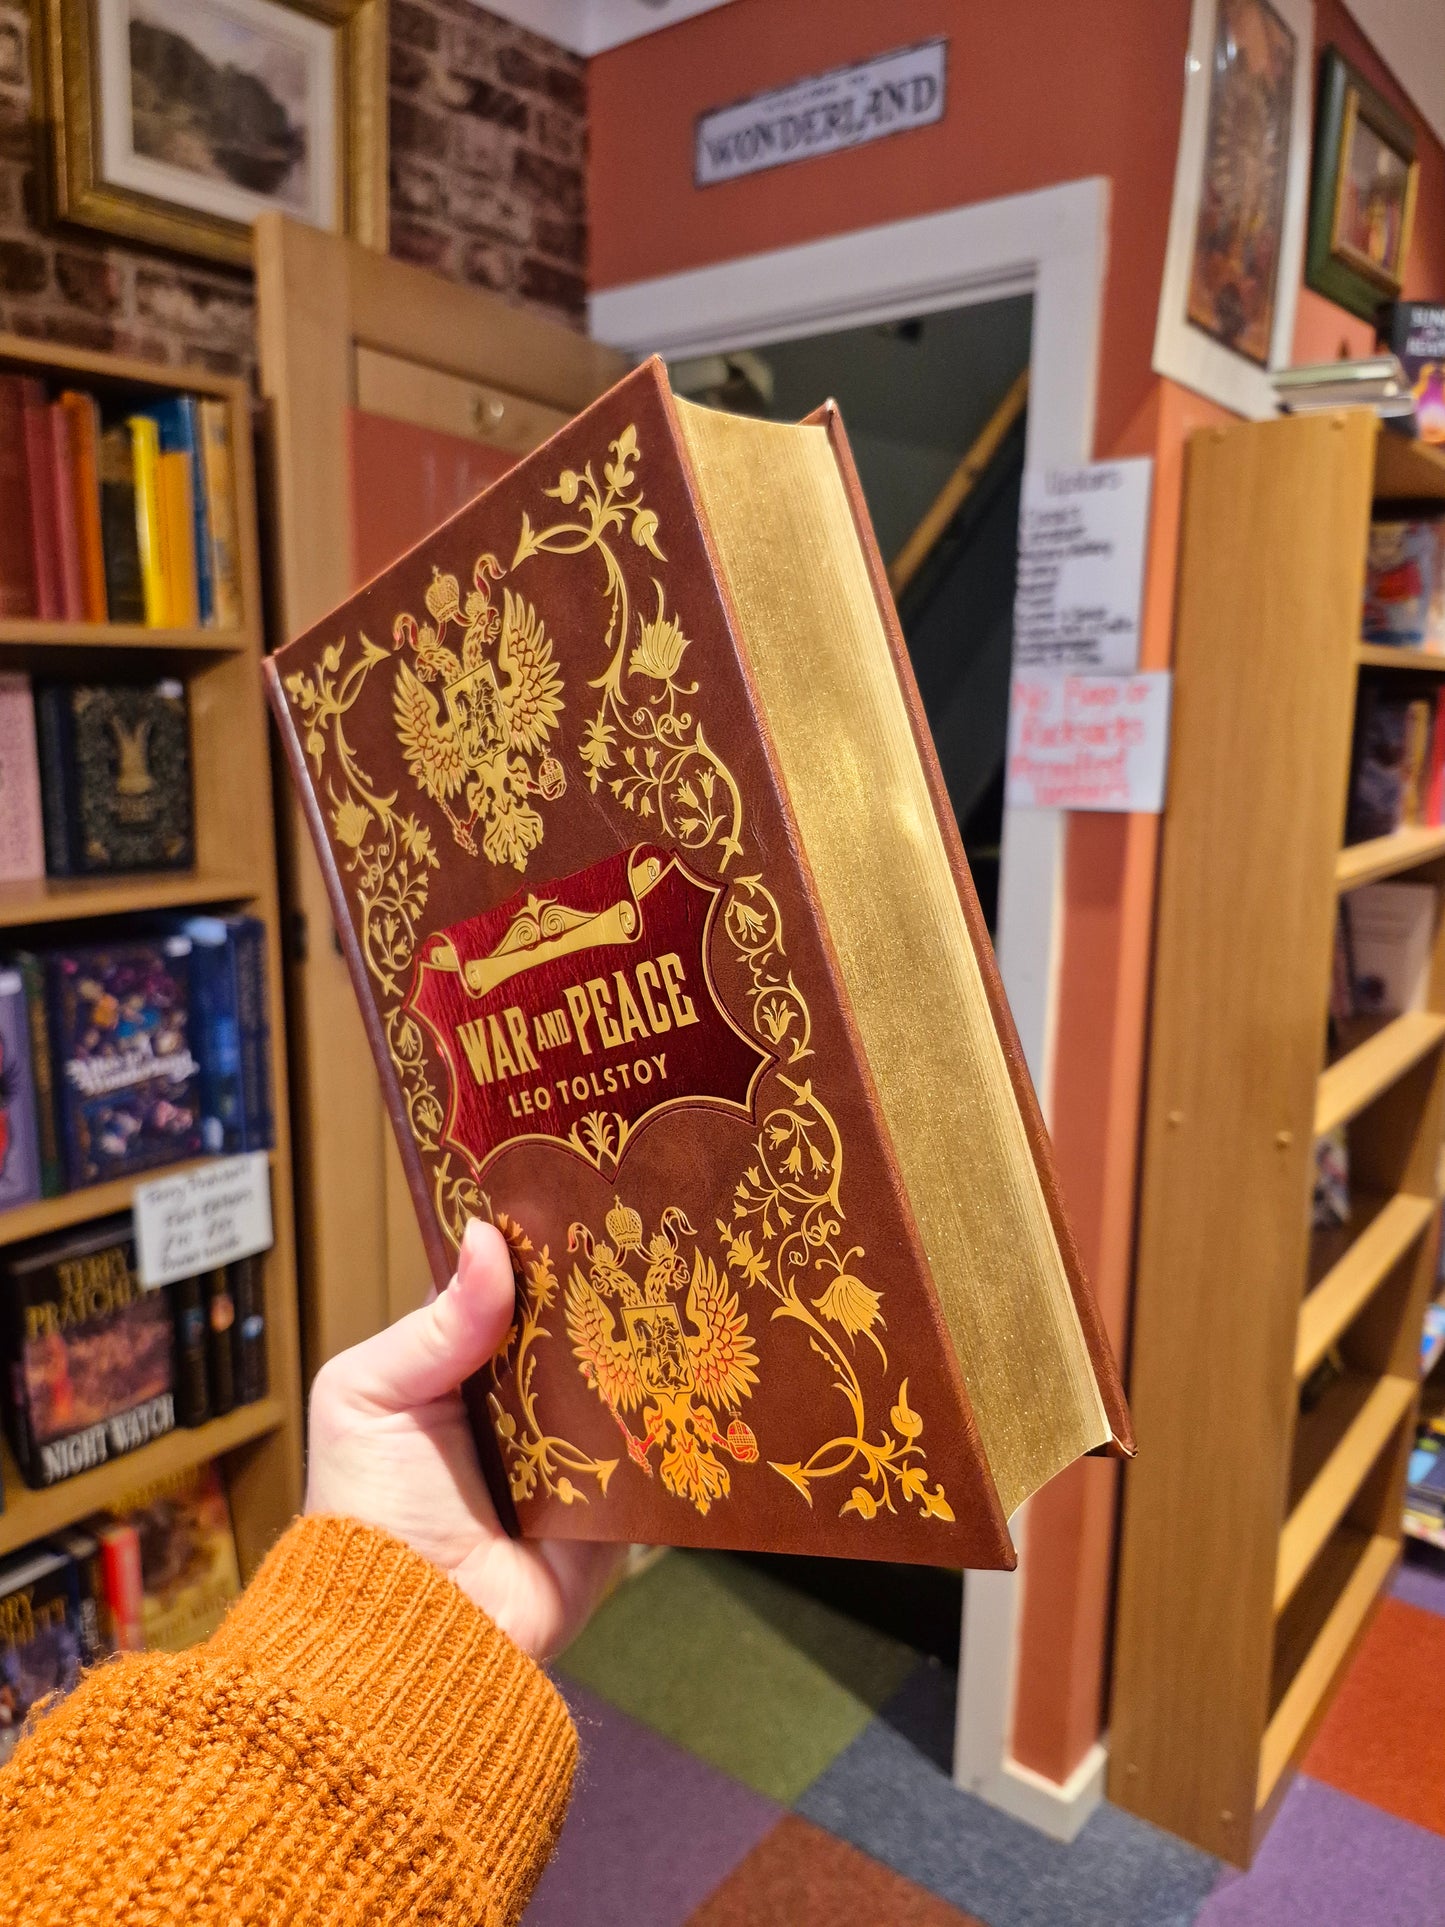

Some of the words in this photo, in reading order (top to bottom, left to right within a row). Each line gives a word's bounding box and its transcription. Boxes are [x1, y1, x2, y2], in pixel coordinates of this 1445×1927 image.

[703, 71, 938, 168] WONDERLAND
[455, 1006, 540, 1086] WAR
[534, 1008, 572, 1052] AND
[563, 952, 700, 1056] PEACE
[508, 1085, 551, 1118] LEO
[556, 1053, 669, 1105] TOLSTOY
[41, 1424, 107, 1484] NIGHT
[110, 1393, 175, 1453] WATCH
